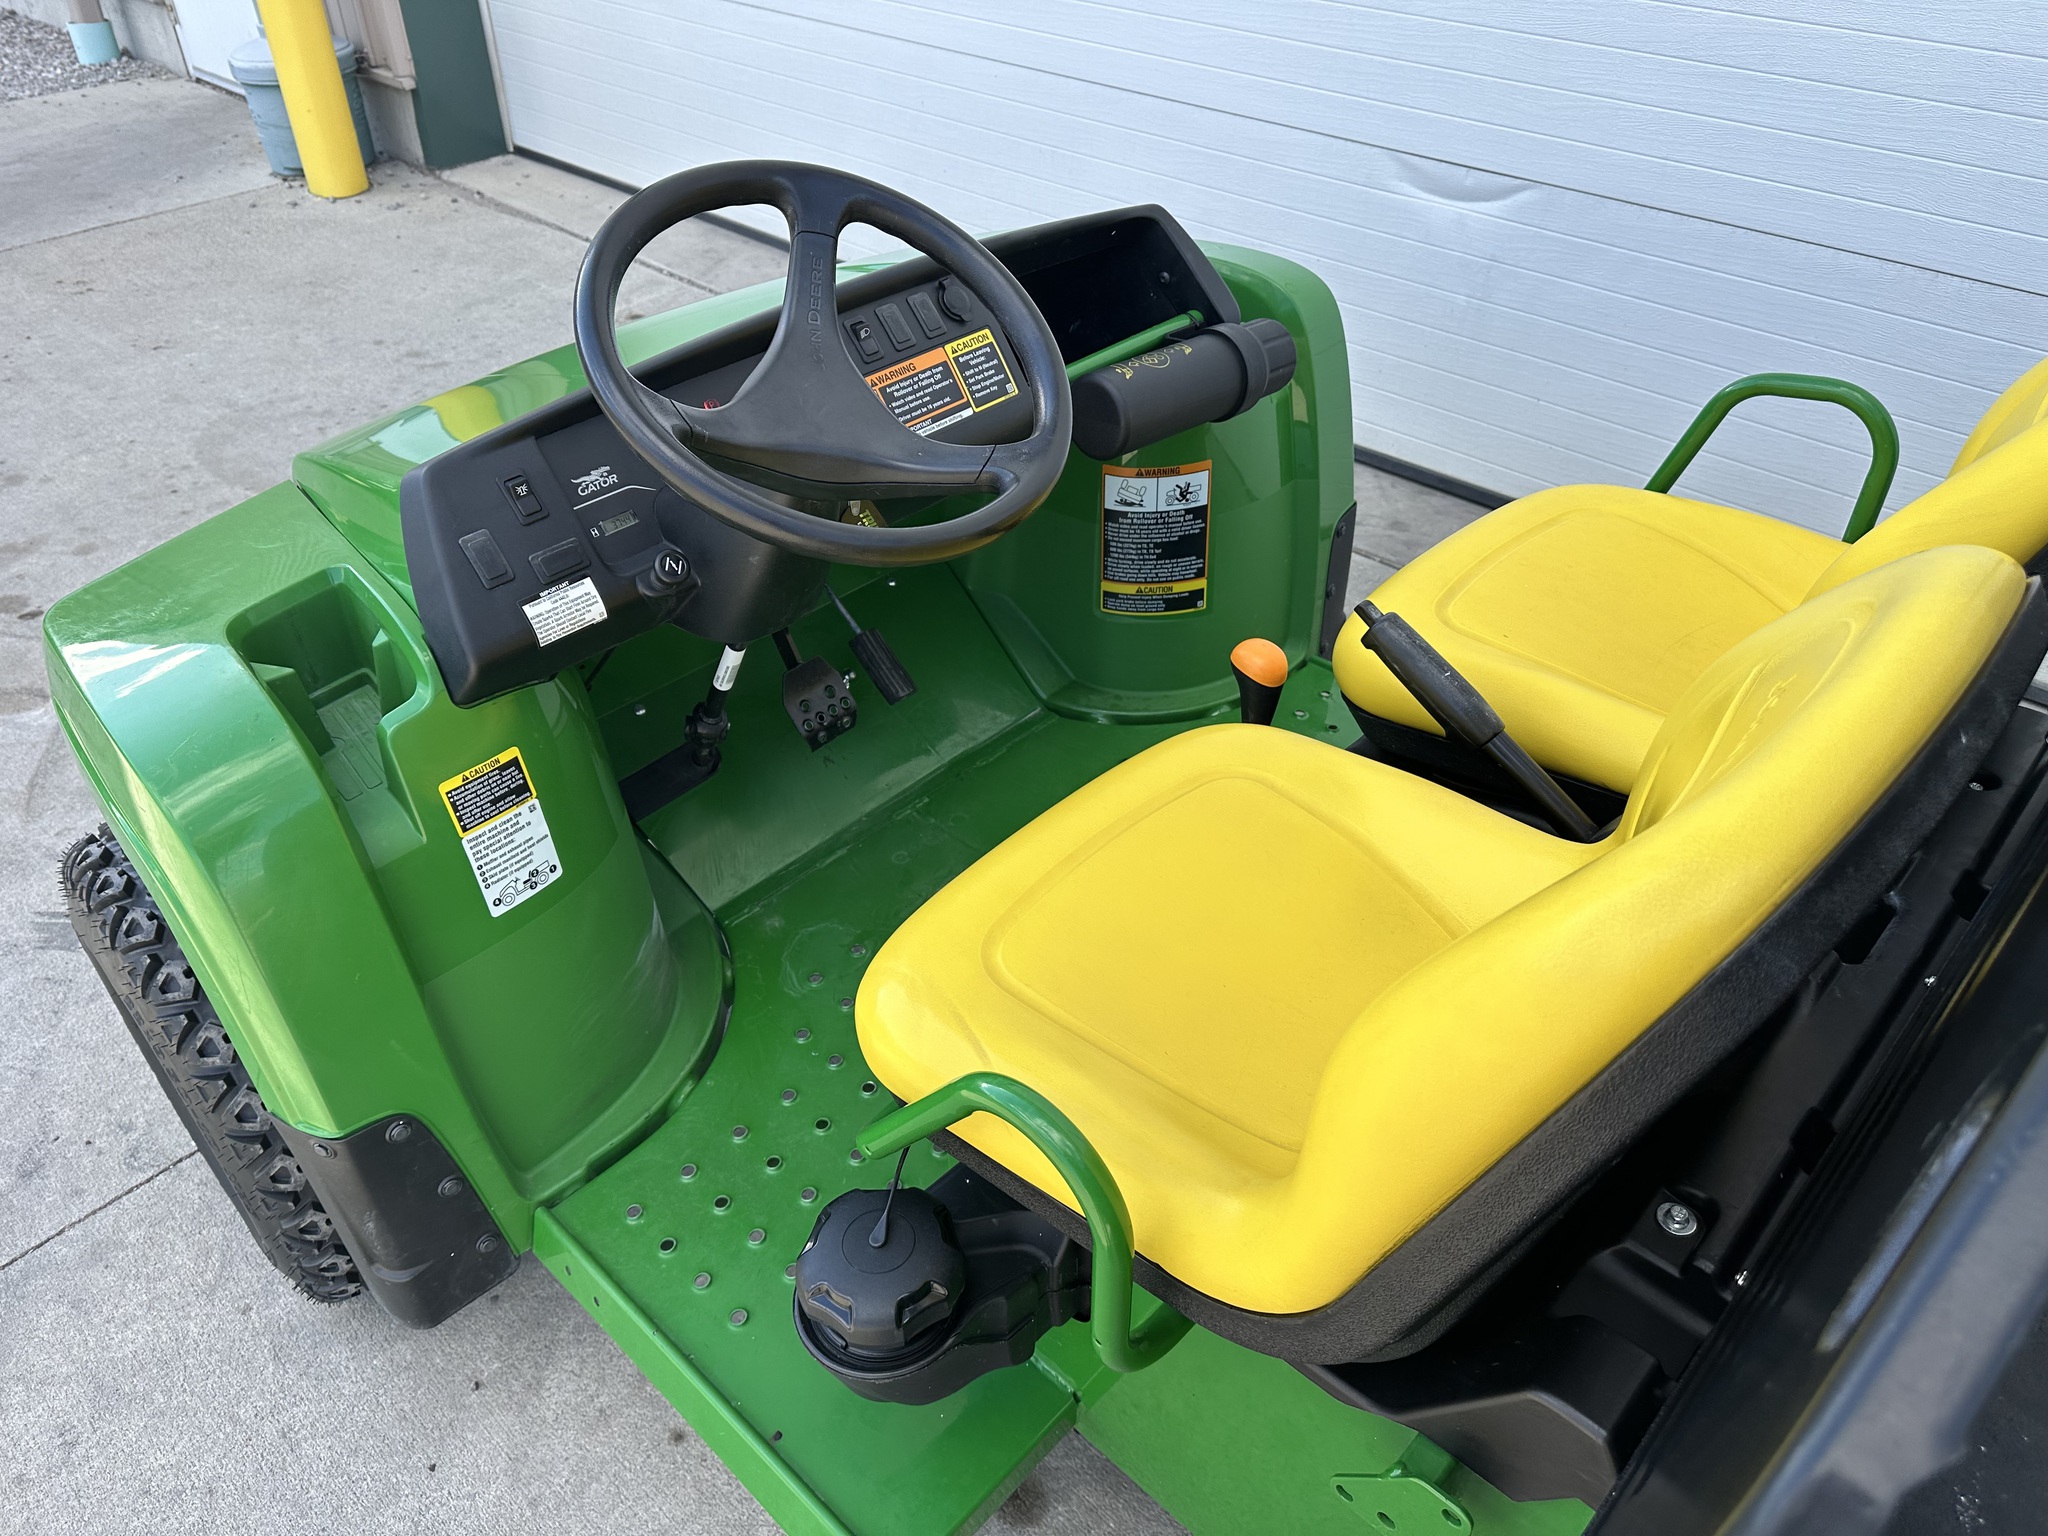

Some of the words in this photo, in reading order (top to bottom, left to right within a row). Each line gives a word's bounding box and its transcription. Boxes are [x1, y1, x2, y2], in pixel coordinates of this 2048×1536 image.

[808, 257, 823, 325] DEERE
[956, 332, 989, 351] CAUTION
[958, 353, 973, 362] Before
[972, 346, 990, 356] Leaving
[968, 355, 986, 365] Vehicle:
[876, 362, 917, 385] WARNING
[886, 383, 899, 392] Avoid
[898, 378, 913, 387] Injury
[918, 370, 932, 379] Death
[893, 386, 912, 397] Rollover
[918, 377, 934, 386] Falling
[909, 418, 932, 432] PORTANT
[1144, 467, 1180, 476] WARNING
[578, 474, 618, 495] GATOR
[1165, 515, 1184, 523] Falling
[539, 581, 569, 597] IMPORTANT
[468, 757, 500, 778] CAUTION
[466, 830, 487, 844] Inspect
[487, 824, 498, 833] and
[498, 816, 513, 827] clean
[512, 811, 522, 819] the
[469, 839, 485, 850] entire
[486, 826, 509, 841] machine
[509, 819, 519, 828] and
[471, 848, 482, 857] pay
[482, 836, 502, 851] special
[503, 824, 525, 840] attention
[474, 852, 489, 862] these
[489, 837, 515, 854] locations:
